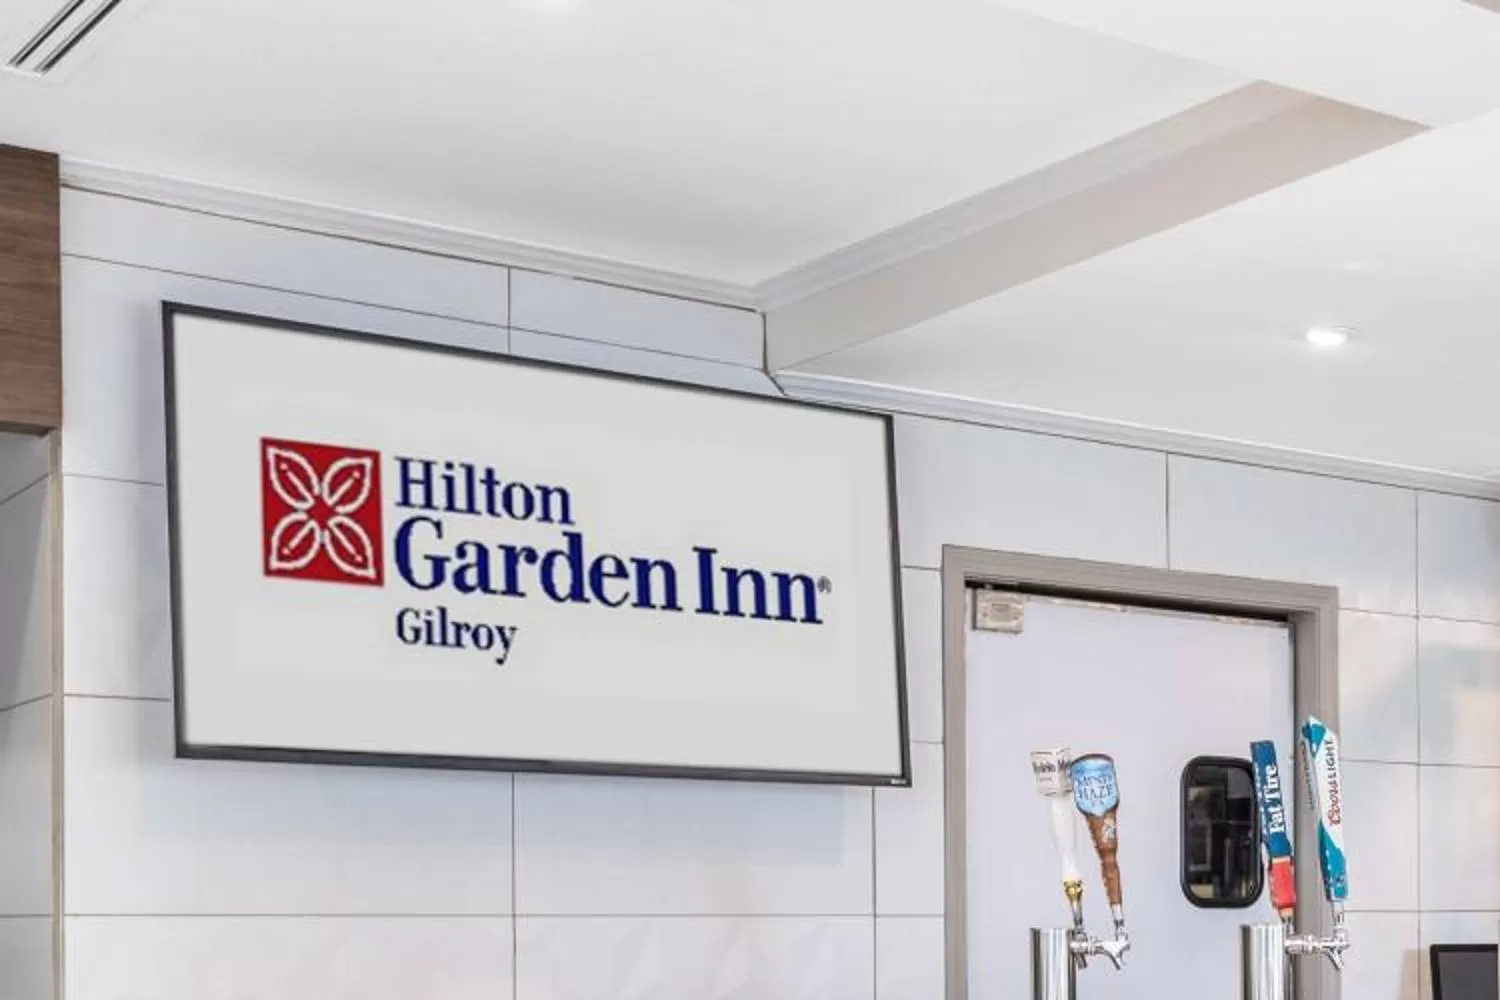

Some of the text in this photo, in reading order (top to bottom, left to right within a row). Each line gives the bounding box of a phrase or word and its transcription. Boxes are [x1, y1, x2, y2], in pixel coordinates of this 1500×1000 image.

[394, 456, 575, 525] Hilton
[394, 515, 683, 612] Garden
[396, 605, 518, 666] Gilroy
[1324, 740, 1338, 780] LIGHT
[1263, 763, 1286, 834] Fat Tire
